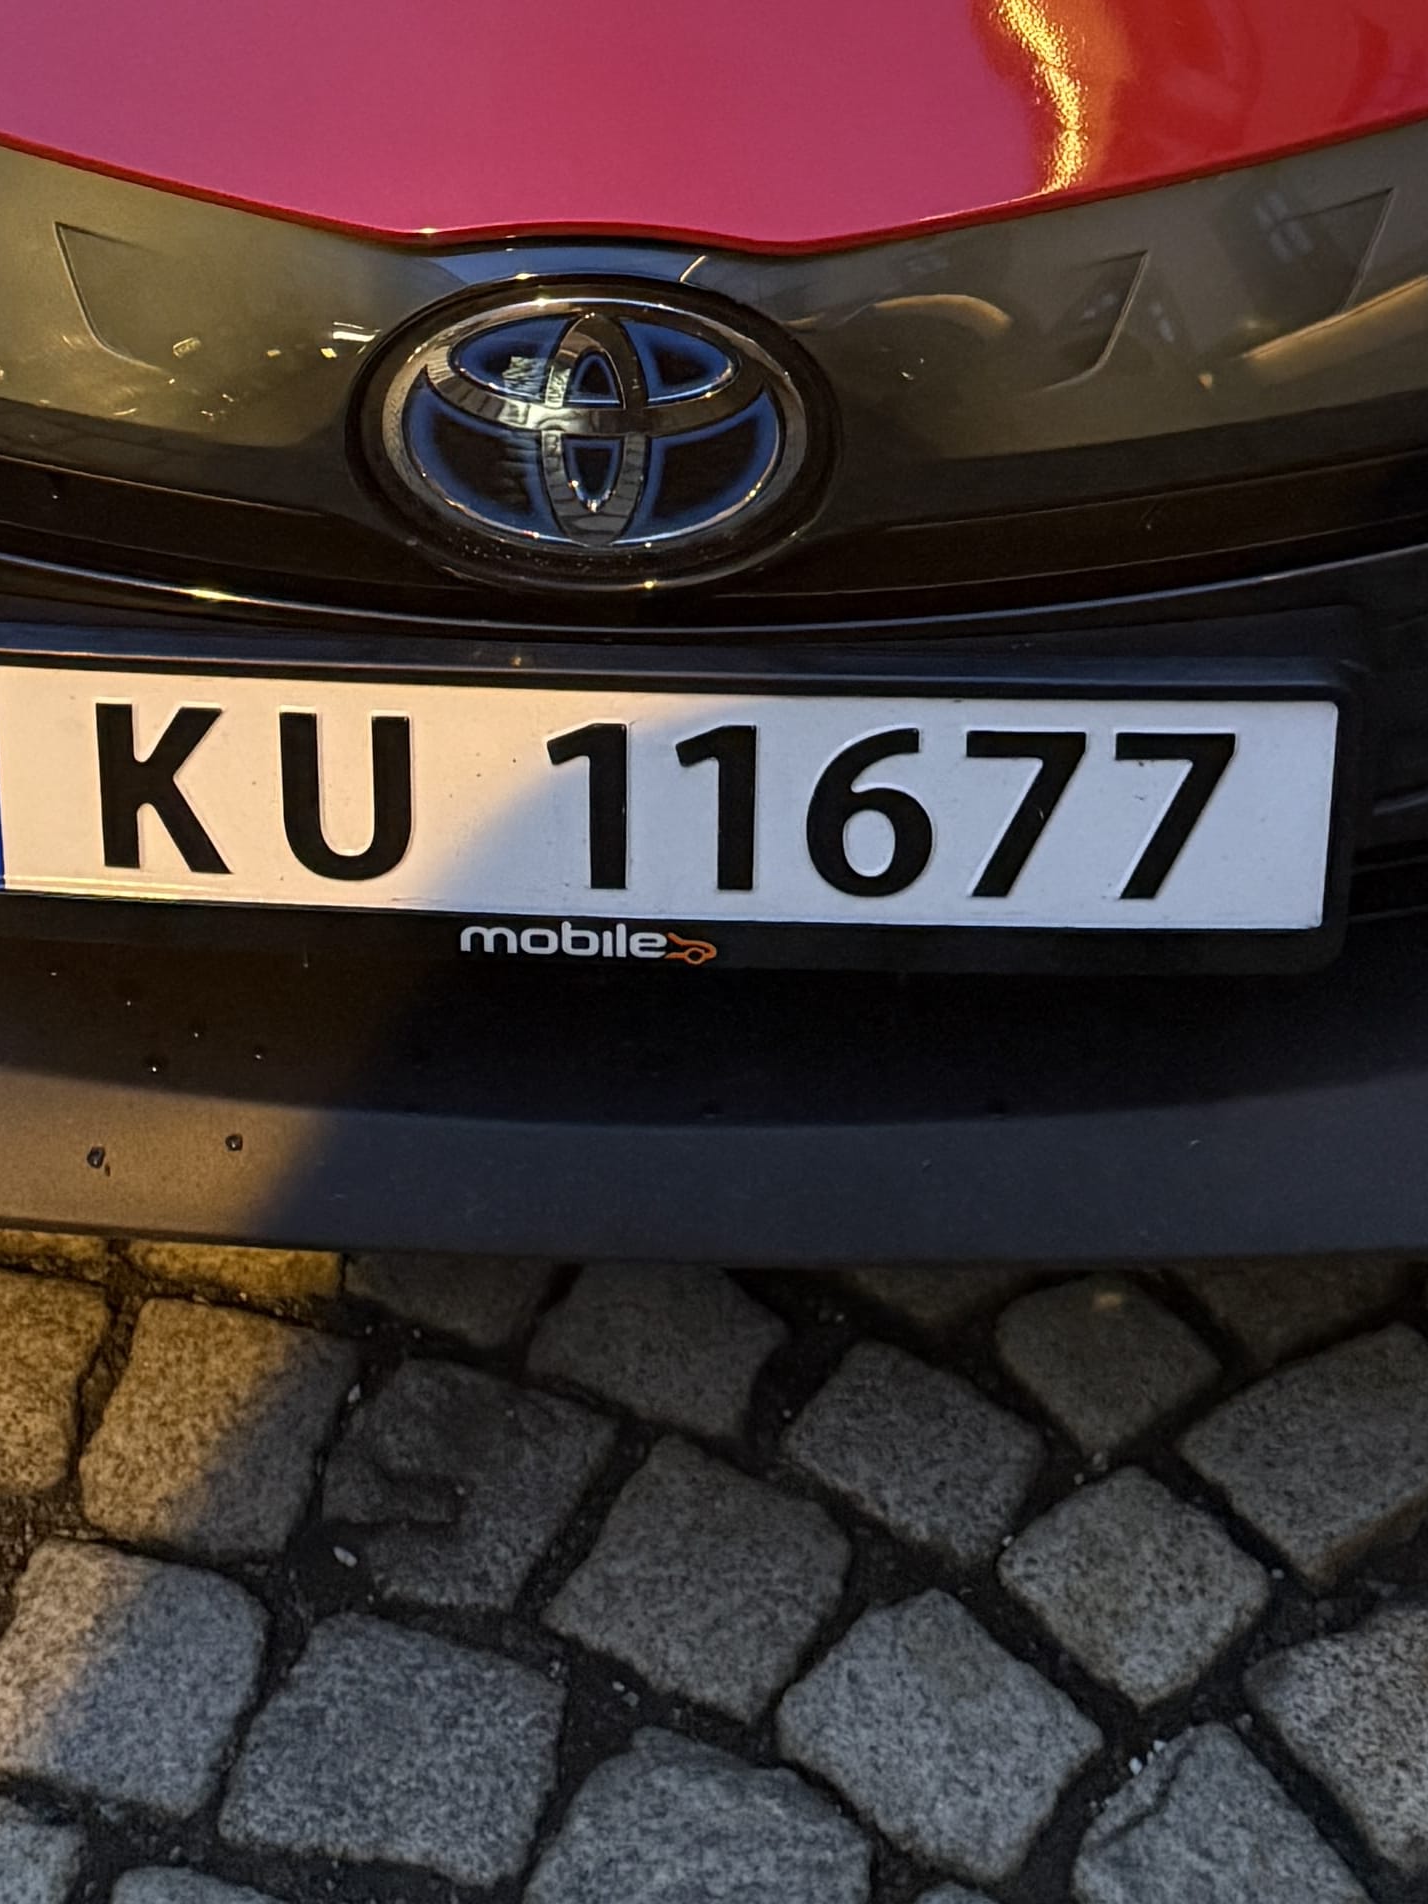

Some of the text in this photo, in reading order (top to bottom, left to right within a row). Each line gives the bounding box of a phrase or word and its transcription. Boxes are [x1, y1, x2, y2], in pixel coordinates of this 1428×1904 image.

[95, 702, 416, 884] KU
[546, 723, 1238, 904] 11677
[460, 921, 668, 958] mobile
